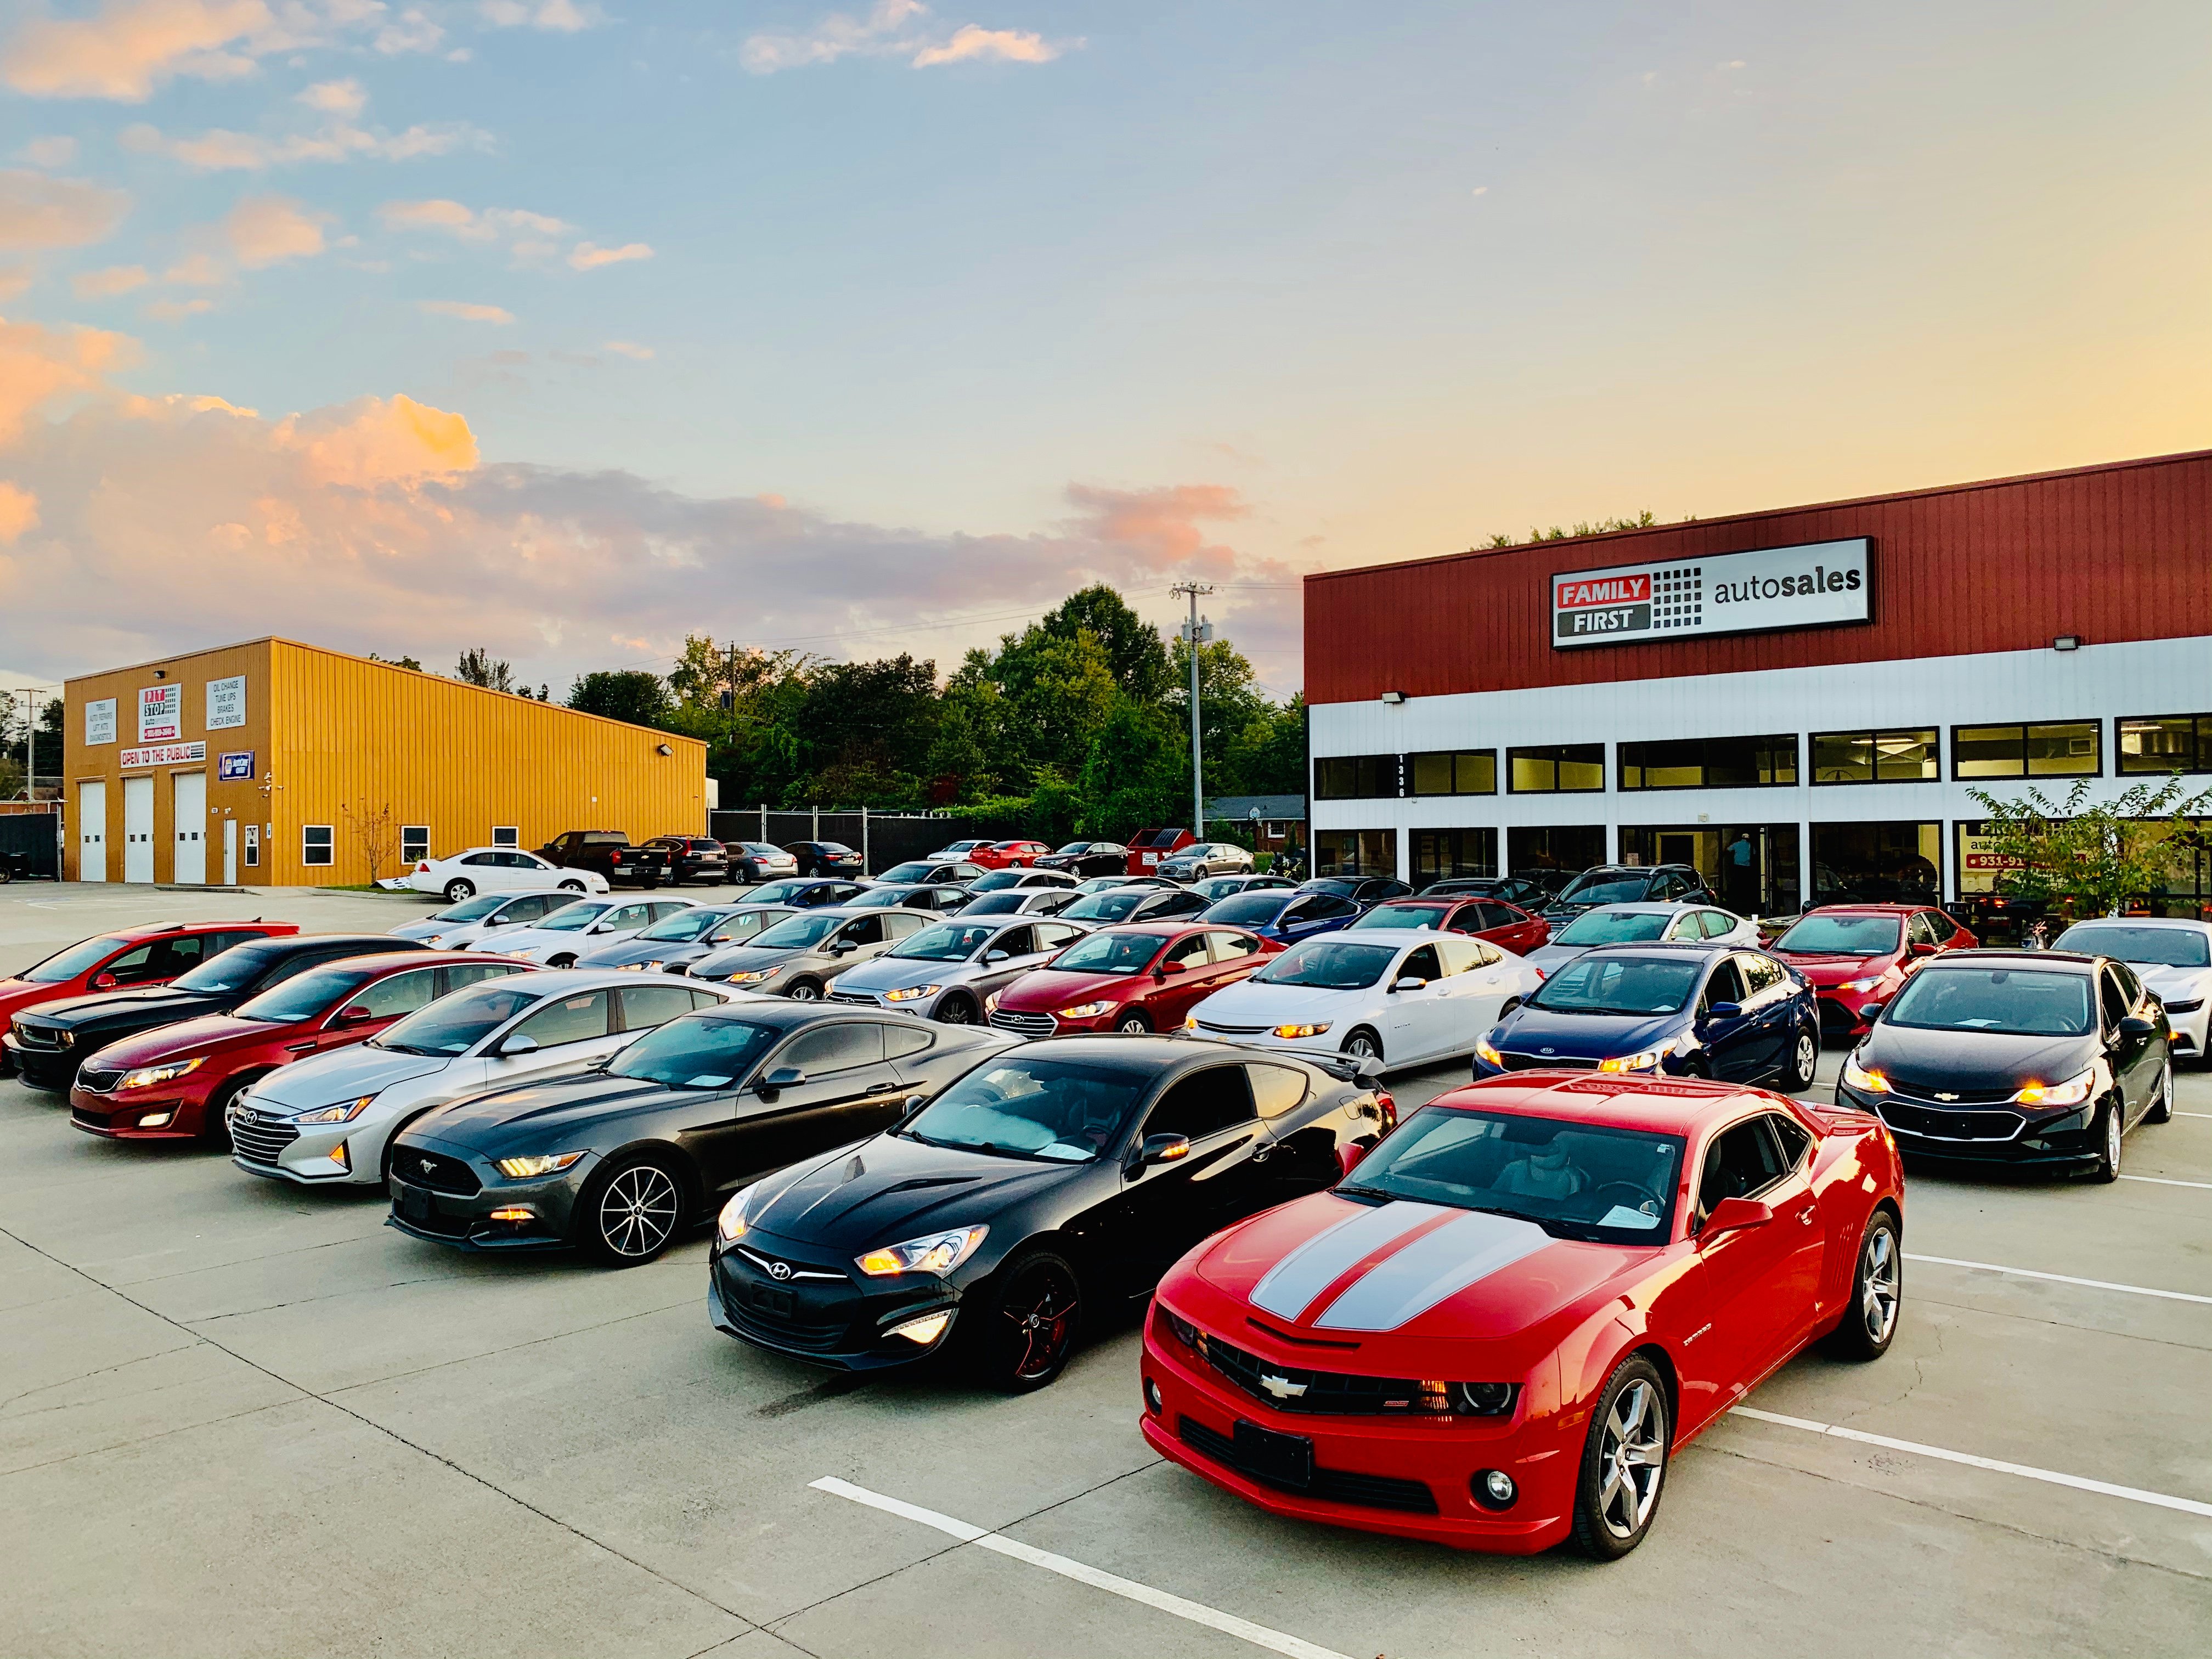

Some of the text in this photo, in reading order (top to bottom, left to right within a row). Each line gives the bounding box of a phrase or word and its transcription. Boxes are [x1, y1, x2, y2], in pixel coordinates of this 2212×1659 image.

[1715, 566, 1861, 604] autosales
[1563, 578, 1645, 605] FAMILY
[1573, 609, 1633, 633] FIRST
[221, 680, 238, 691] CHANGE
[147, 690, 162, 702] PIT
[215, 692, 236, 702] TUNE UPS
[145, 703, 164, 716] STOP
[217, 703, 234, 714] BRAKES
[211, 714, 241, 726] CHECK ENGINE
[122, 746, 190, 765] OPEN TO THE PUBLIC
